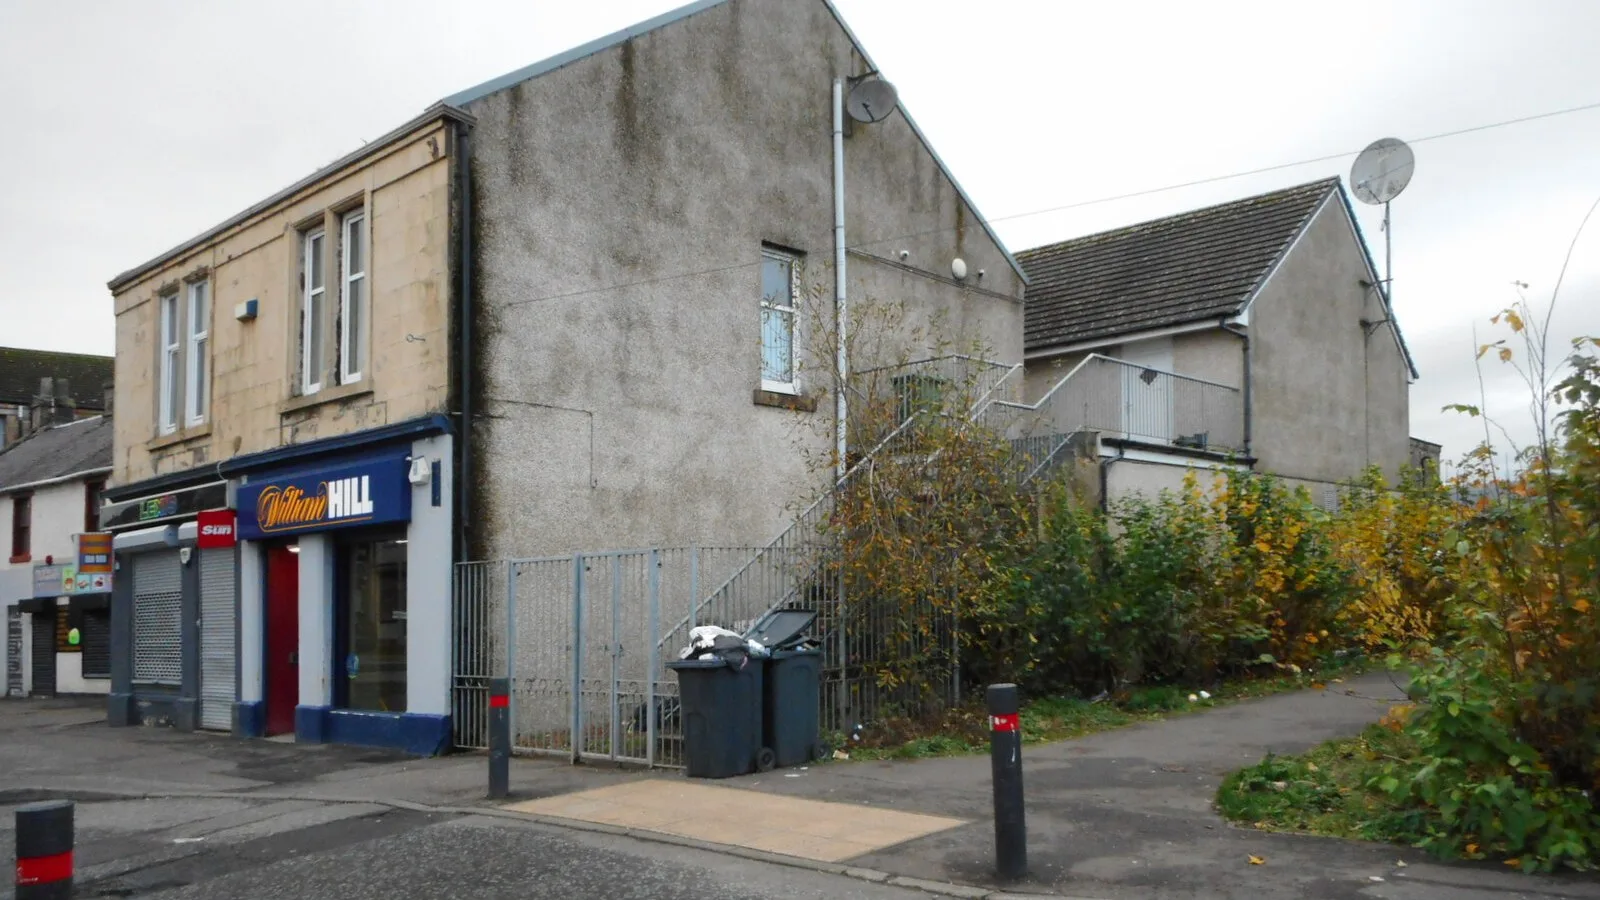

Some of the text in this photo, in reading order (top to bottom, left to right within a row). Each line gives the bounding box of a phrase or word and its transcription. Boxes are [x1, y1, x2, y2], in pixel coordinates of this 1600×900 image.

[258, 475, 373, 529] William HILL
[202, 524, 232, 535] Sun
